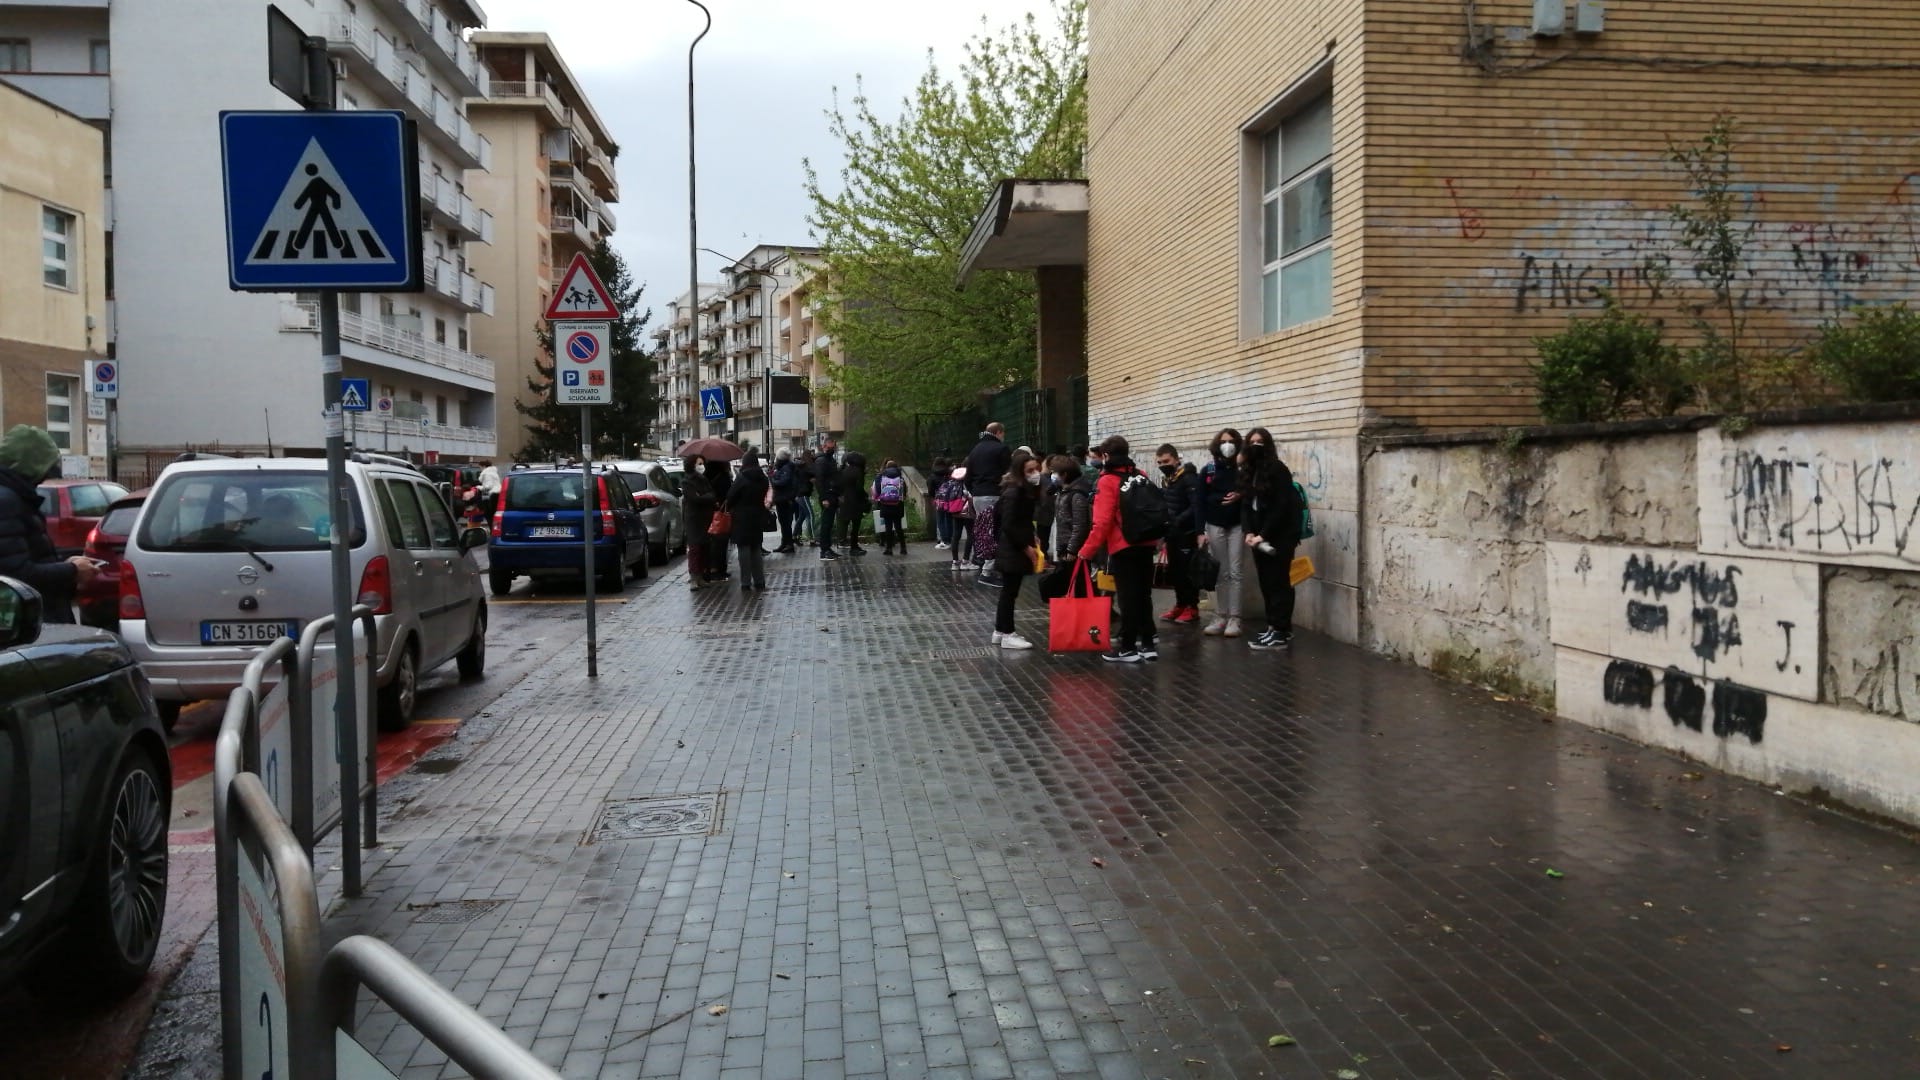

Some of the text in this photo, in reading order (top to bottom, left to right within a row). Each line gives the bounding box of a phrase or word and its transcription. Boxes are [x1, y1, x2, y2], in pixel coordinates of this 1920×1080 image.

[566, 373, 576, 385] P
[212, 624, 231, 640] CN
[237, 624, 286, 640] 316GN
